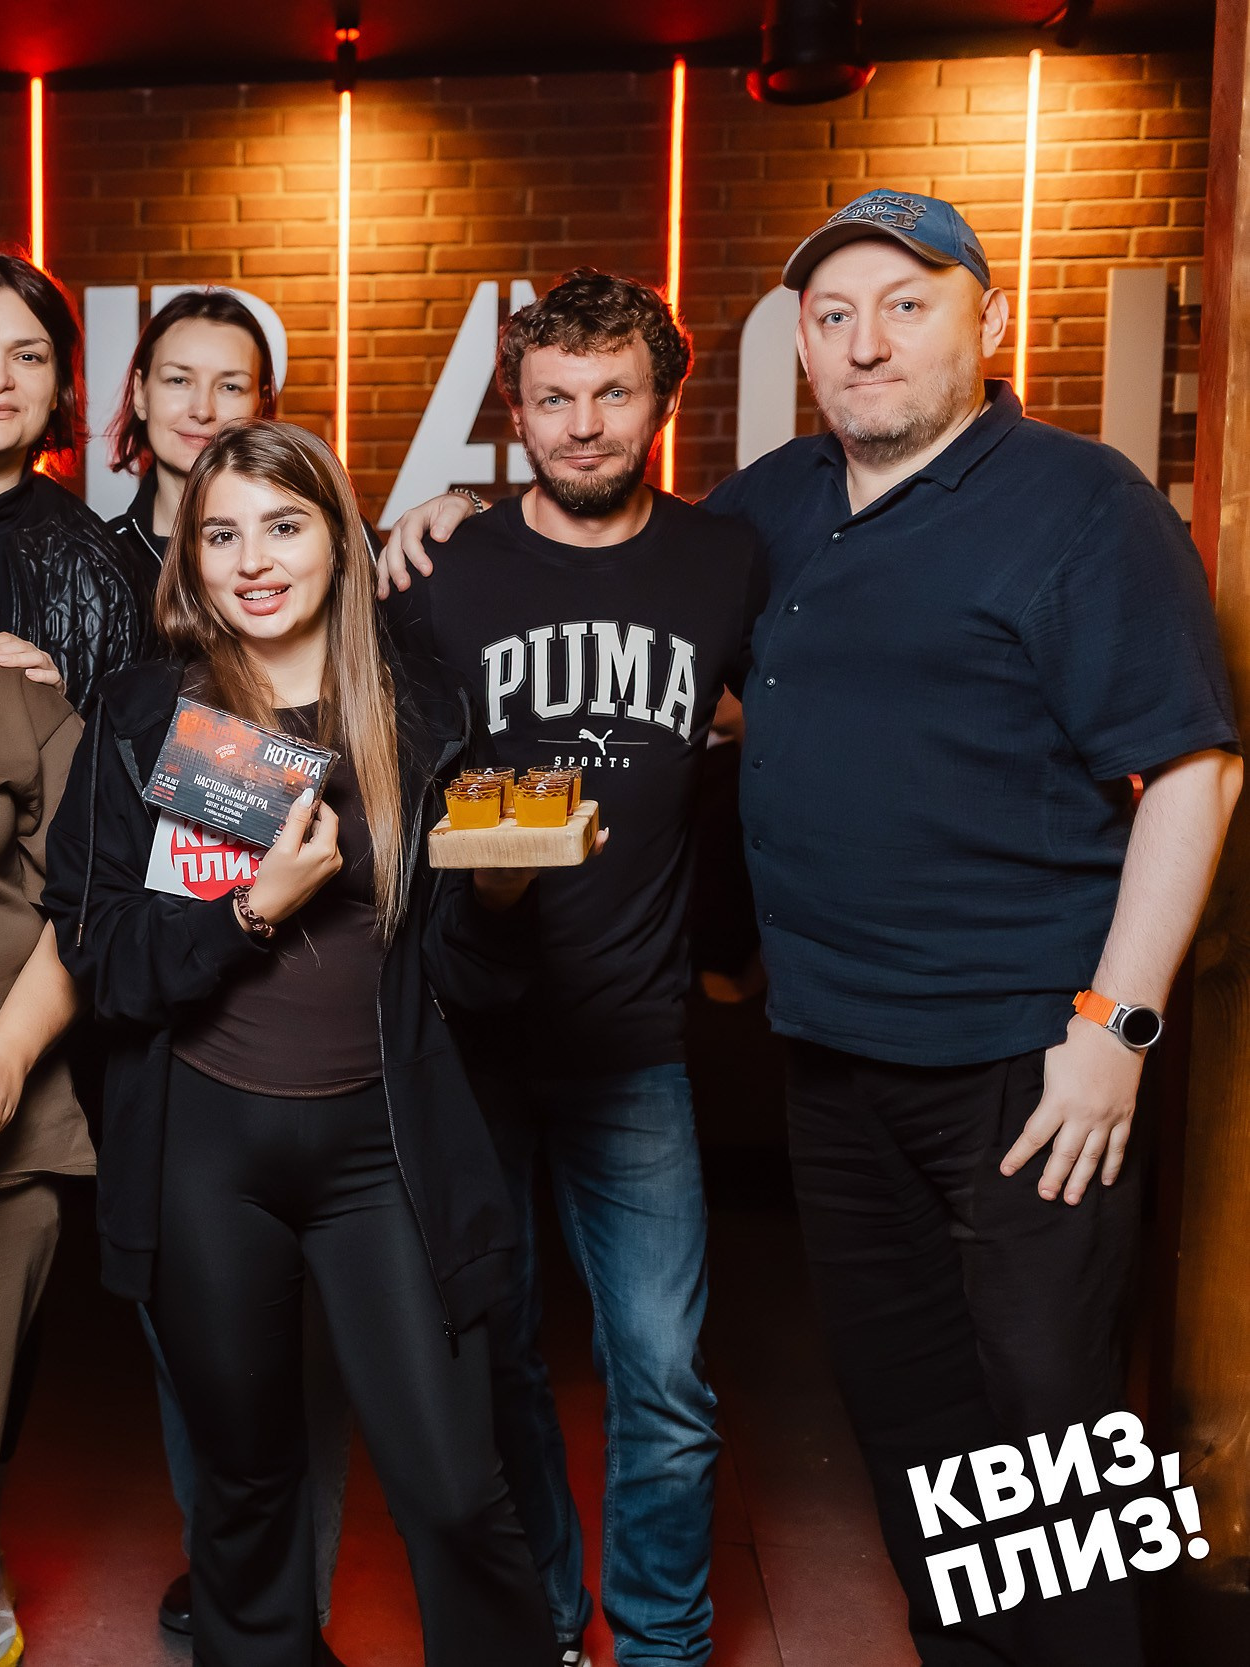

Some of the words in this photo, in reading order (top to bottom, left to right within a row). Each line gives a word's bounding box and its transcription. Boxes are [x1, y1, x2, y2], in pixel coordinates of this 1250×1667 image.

[481, 620, 696, 746] PUMA
[264, 743, 321, 780] КОТЯТА
[554, 756, 630, 768] SPORTS
[193, 773, 248, 802] НАСТОЛЬНАЯ
[246, 792, 269, 811] ИГРА
[176, 820, 248, 848] КВ
